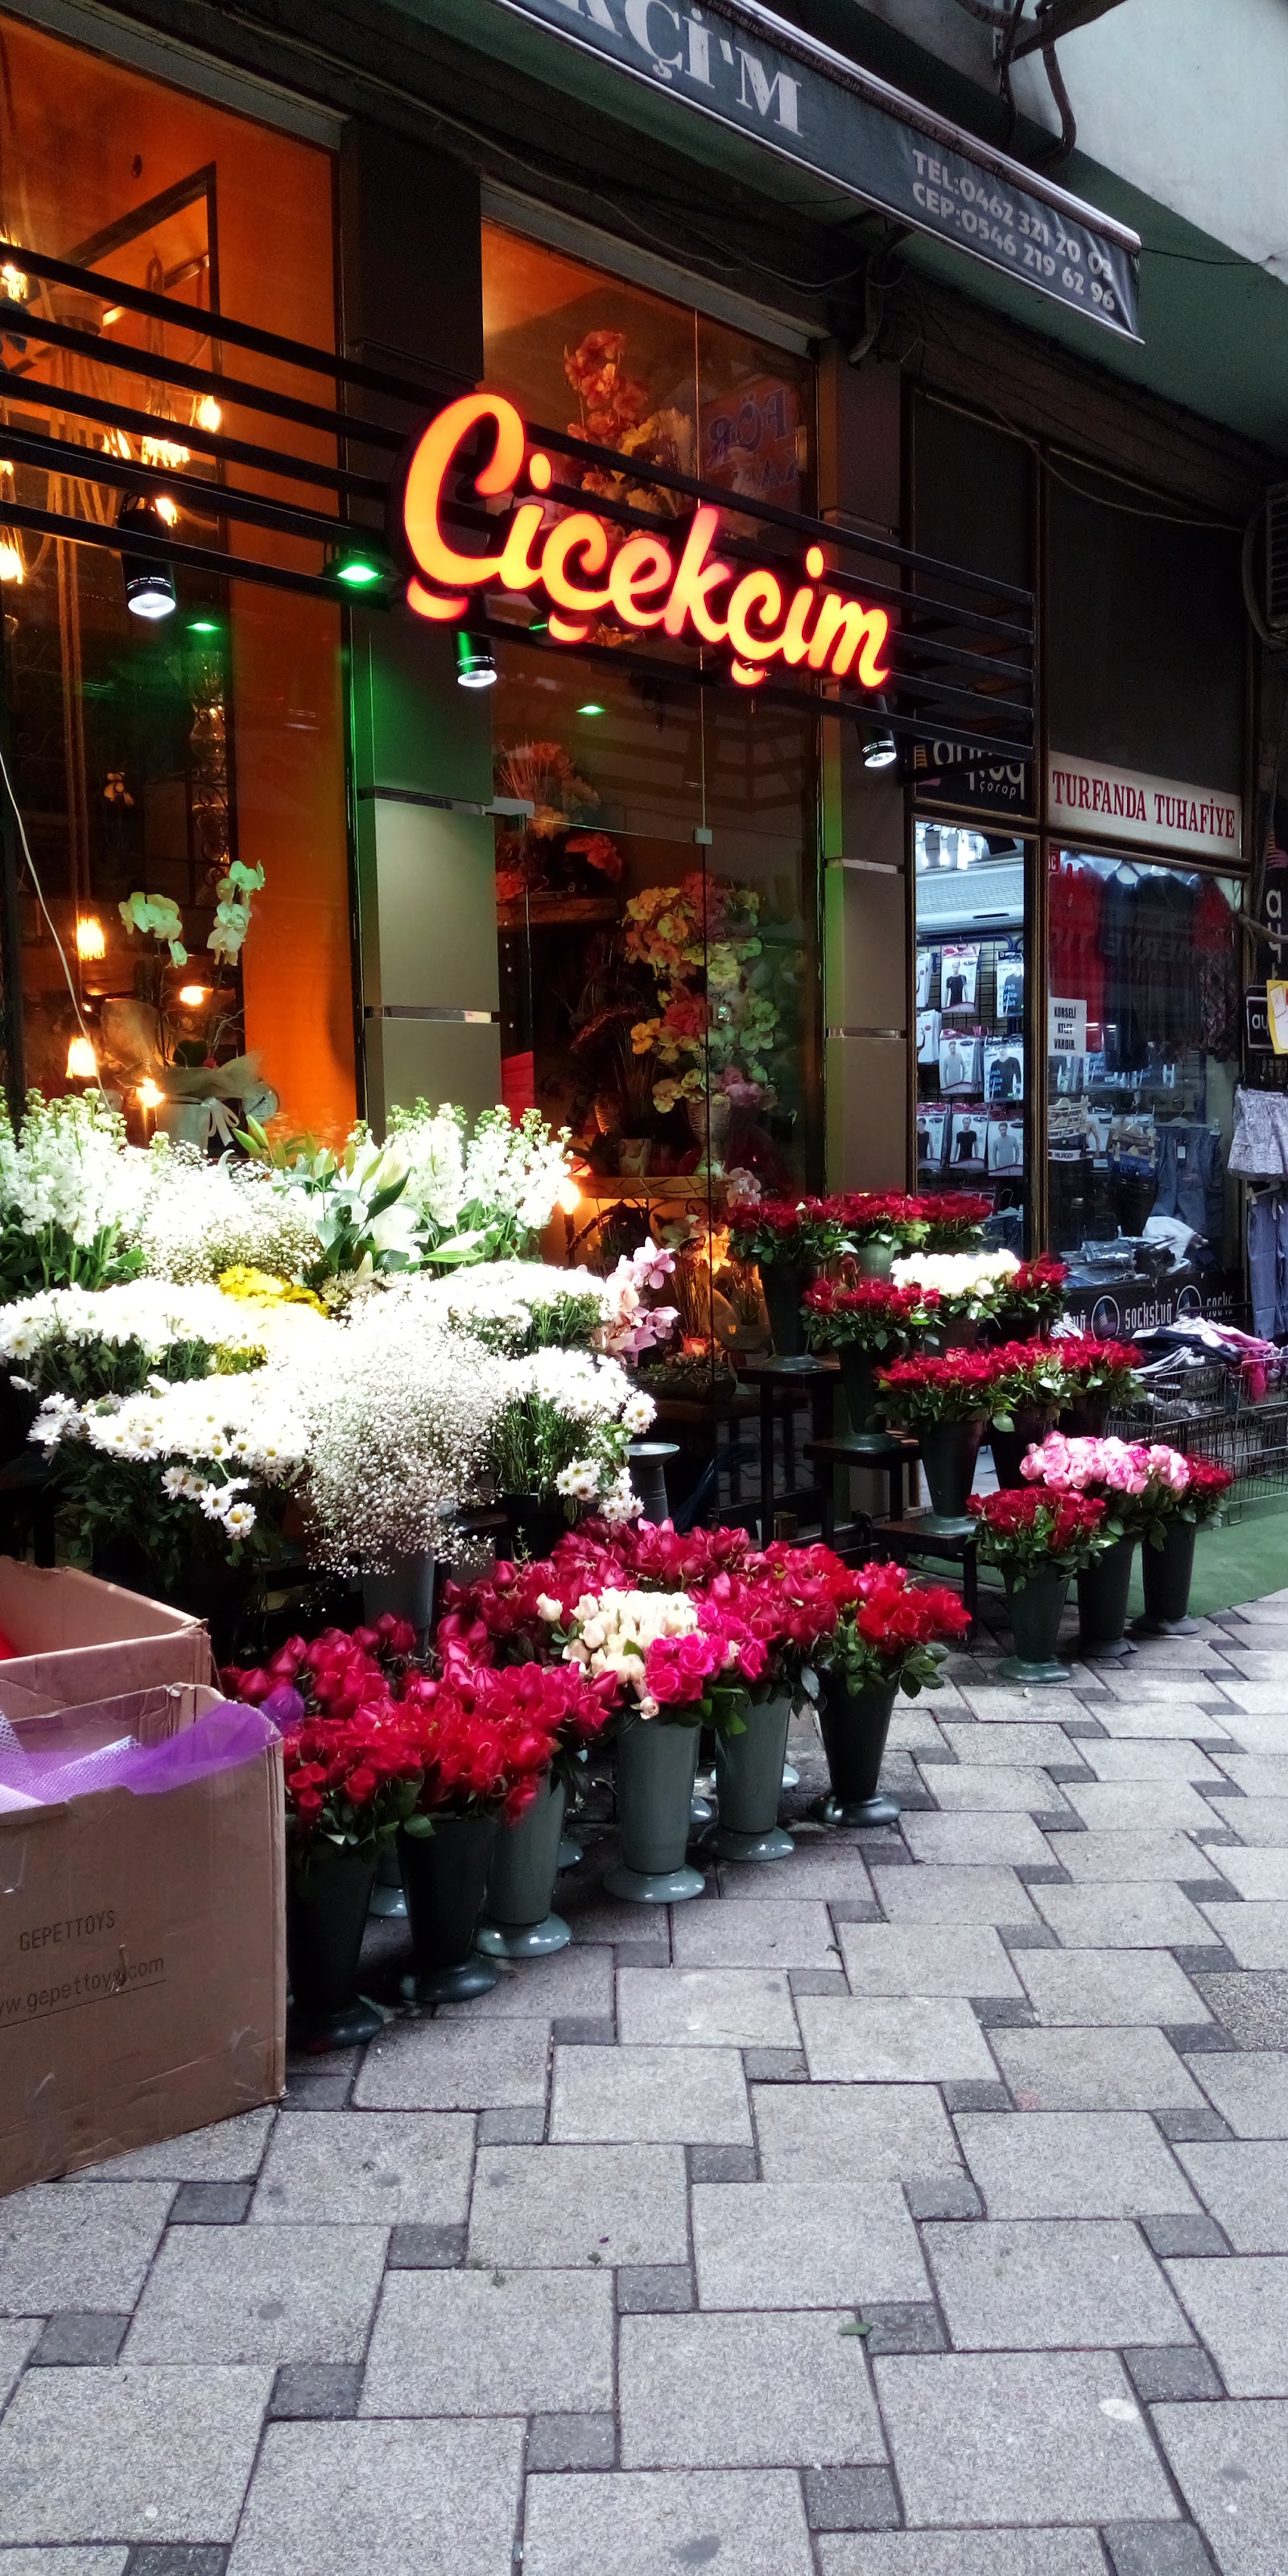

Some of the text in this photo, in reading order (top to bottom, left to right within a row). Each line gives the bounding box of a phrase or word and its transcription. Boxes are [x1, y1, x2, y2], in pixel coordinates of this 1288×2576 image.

[912, 150, 1013, 226] TEL:0462
[1018, 210, 1050, 246] 321
[1055, 232, 1080, 262] 20
[912, 182, 1116, 312] CEP:0546 219 62 96
[402, 392, 892, 687] Çiçekçim
[980, 780, 1017, 800] çorap
[1052, 770, 1235, 839] TURFANDA TUHAFİYE
[19, 1909, 117, 1952] GEPETTOYS
